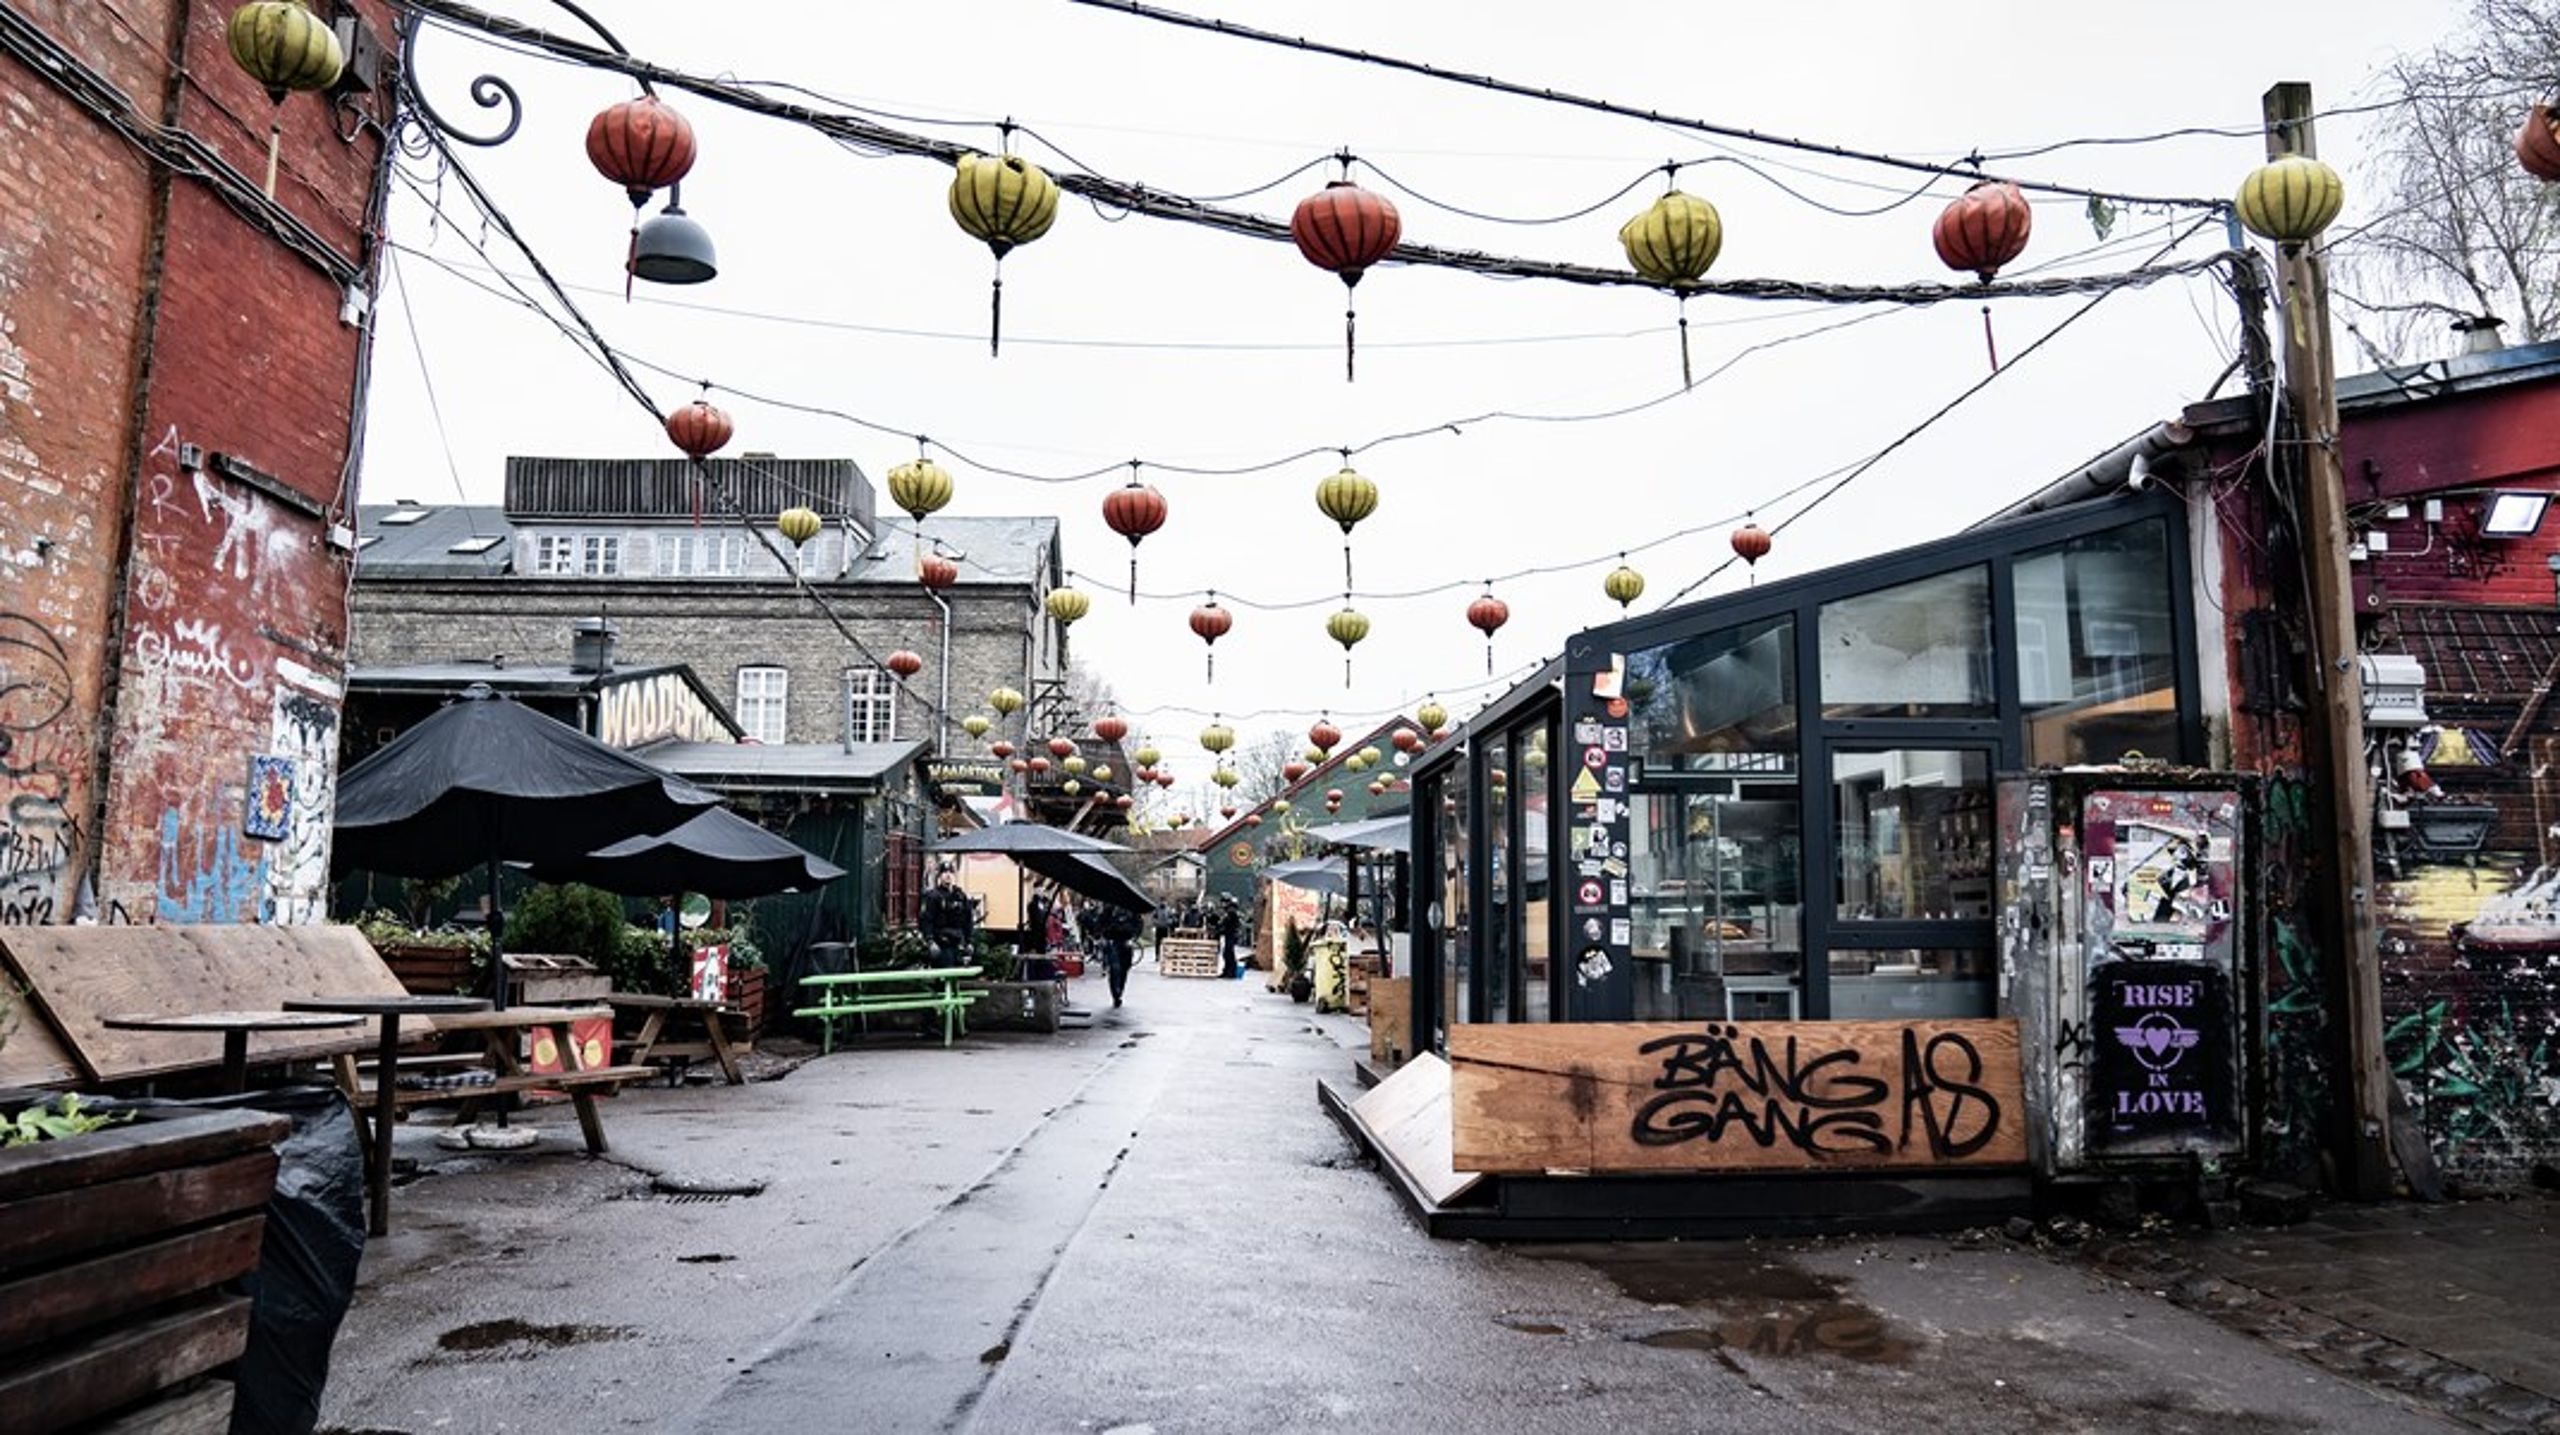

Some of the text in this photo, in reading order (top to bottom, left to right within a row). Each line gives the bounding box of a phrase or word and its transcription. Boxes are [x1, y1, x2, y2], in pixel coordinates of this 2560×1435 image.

[2123, 984, 2194, 1007] RISE
[1638, 1023, 1889, 1109] BÄNG
[2148, 1073, 2169, 1087] IN
[2116, 1090, 2205, 1114] LOVE
[1631, 1089, 1893, 1161] GANG
